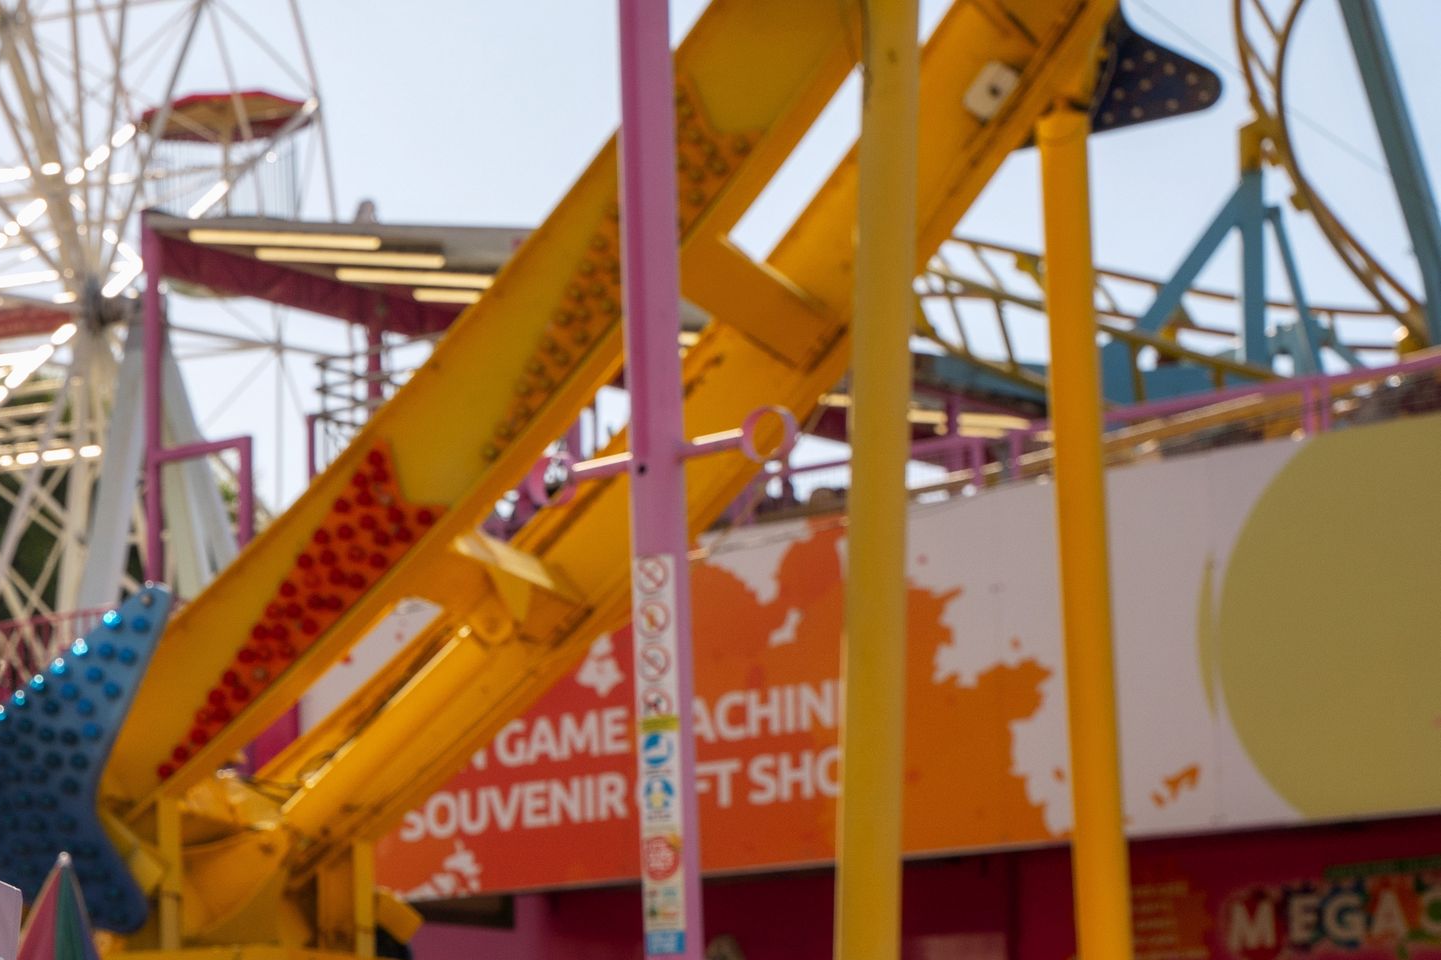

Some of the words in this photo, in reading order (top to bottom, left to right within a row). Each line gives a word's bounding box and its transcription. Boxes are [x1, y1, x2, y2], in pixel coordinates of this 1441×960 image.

[494, 706, 630, 769] GAME
[691, 678, 844, 744] ACHIN
[400, 771, 629, 843] SOUVENIR
[748, 746, 844, 807] SHO
